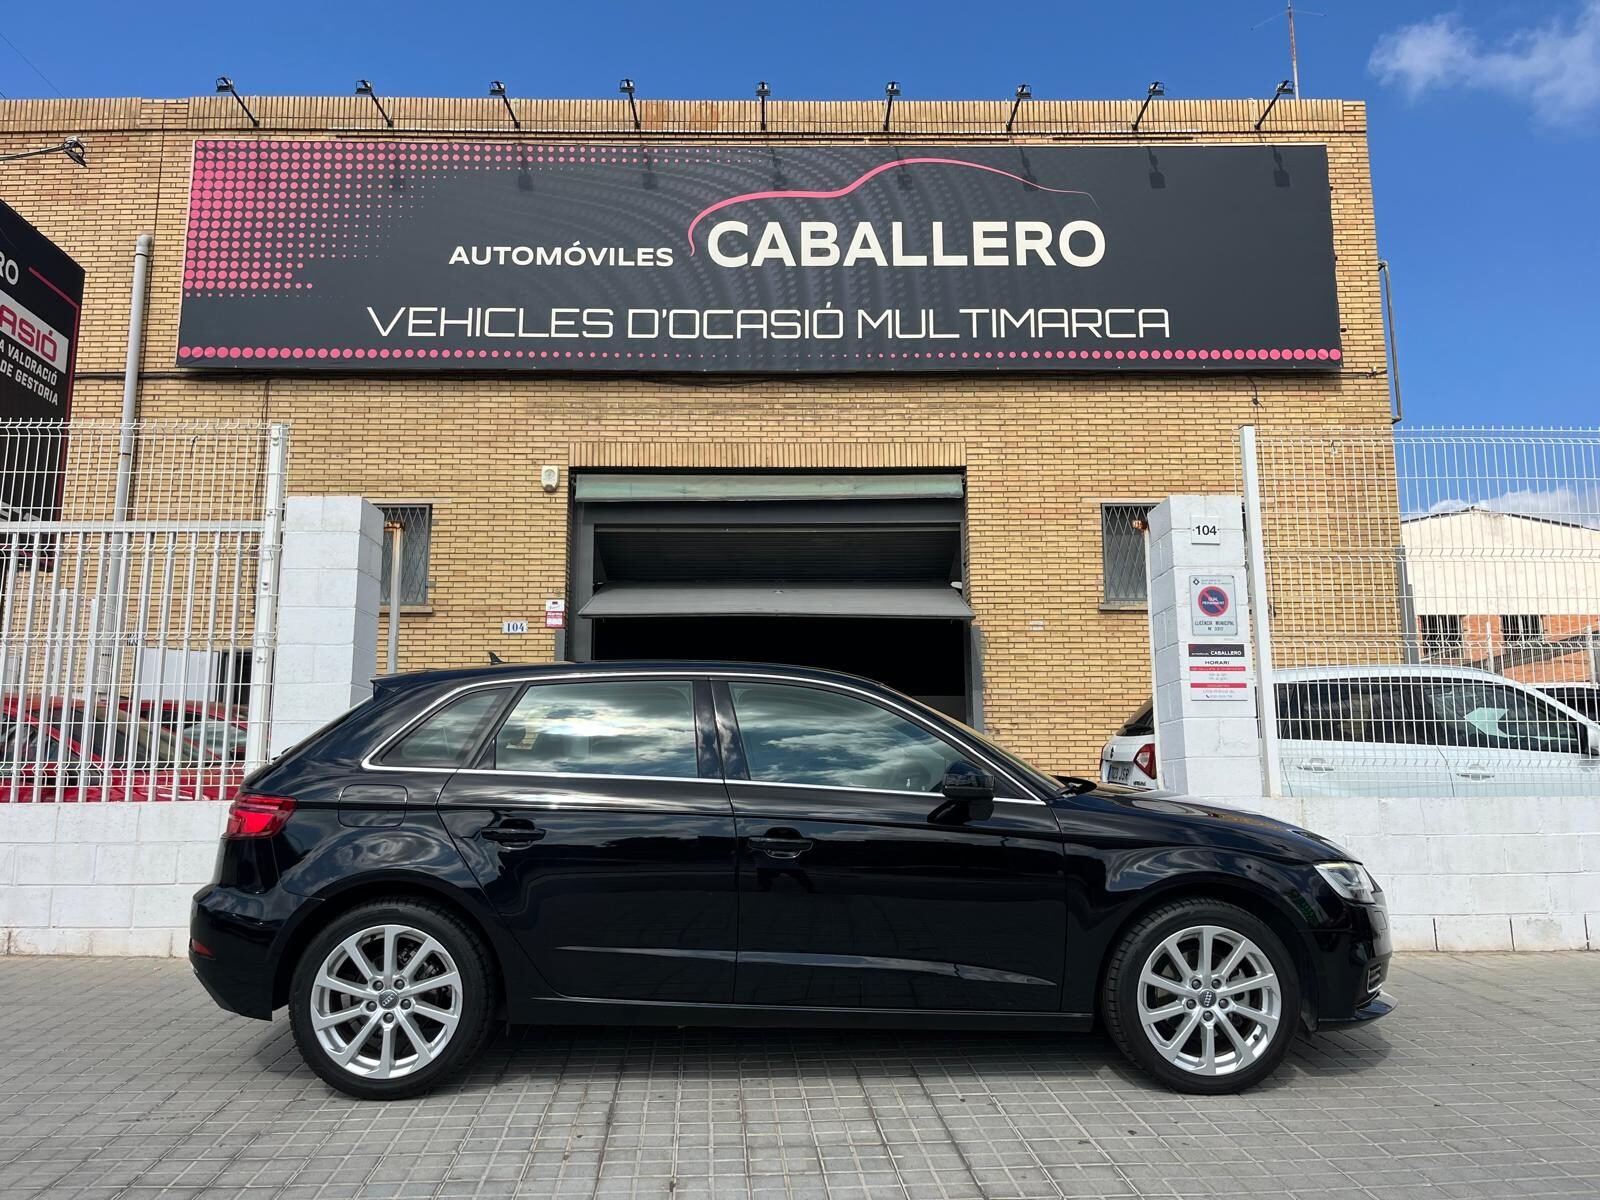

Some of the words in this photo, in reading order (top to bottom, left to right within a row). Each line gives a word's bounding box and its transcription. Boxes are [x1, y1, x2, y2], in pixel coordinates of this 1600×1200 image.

[449, 240, 674, 267] AUTOMÓVILES
[707, 219, 1107, 268] CABALLERO
[366, 306, 614, 339] VEHICLES
[627, 301, 845, 340] D'OCASIÓ
[857, 307, 1171, 339] MULTIMARCA
[0, 359, 13, 378] DE
[15, 368, 59, 406] GESTORIA
[8, 343, 58, 386] VALORACIÓ
[1195, 525, 1218, 536] 104
[506, 622, 525, 632] 104
